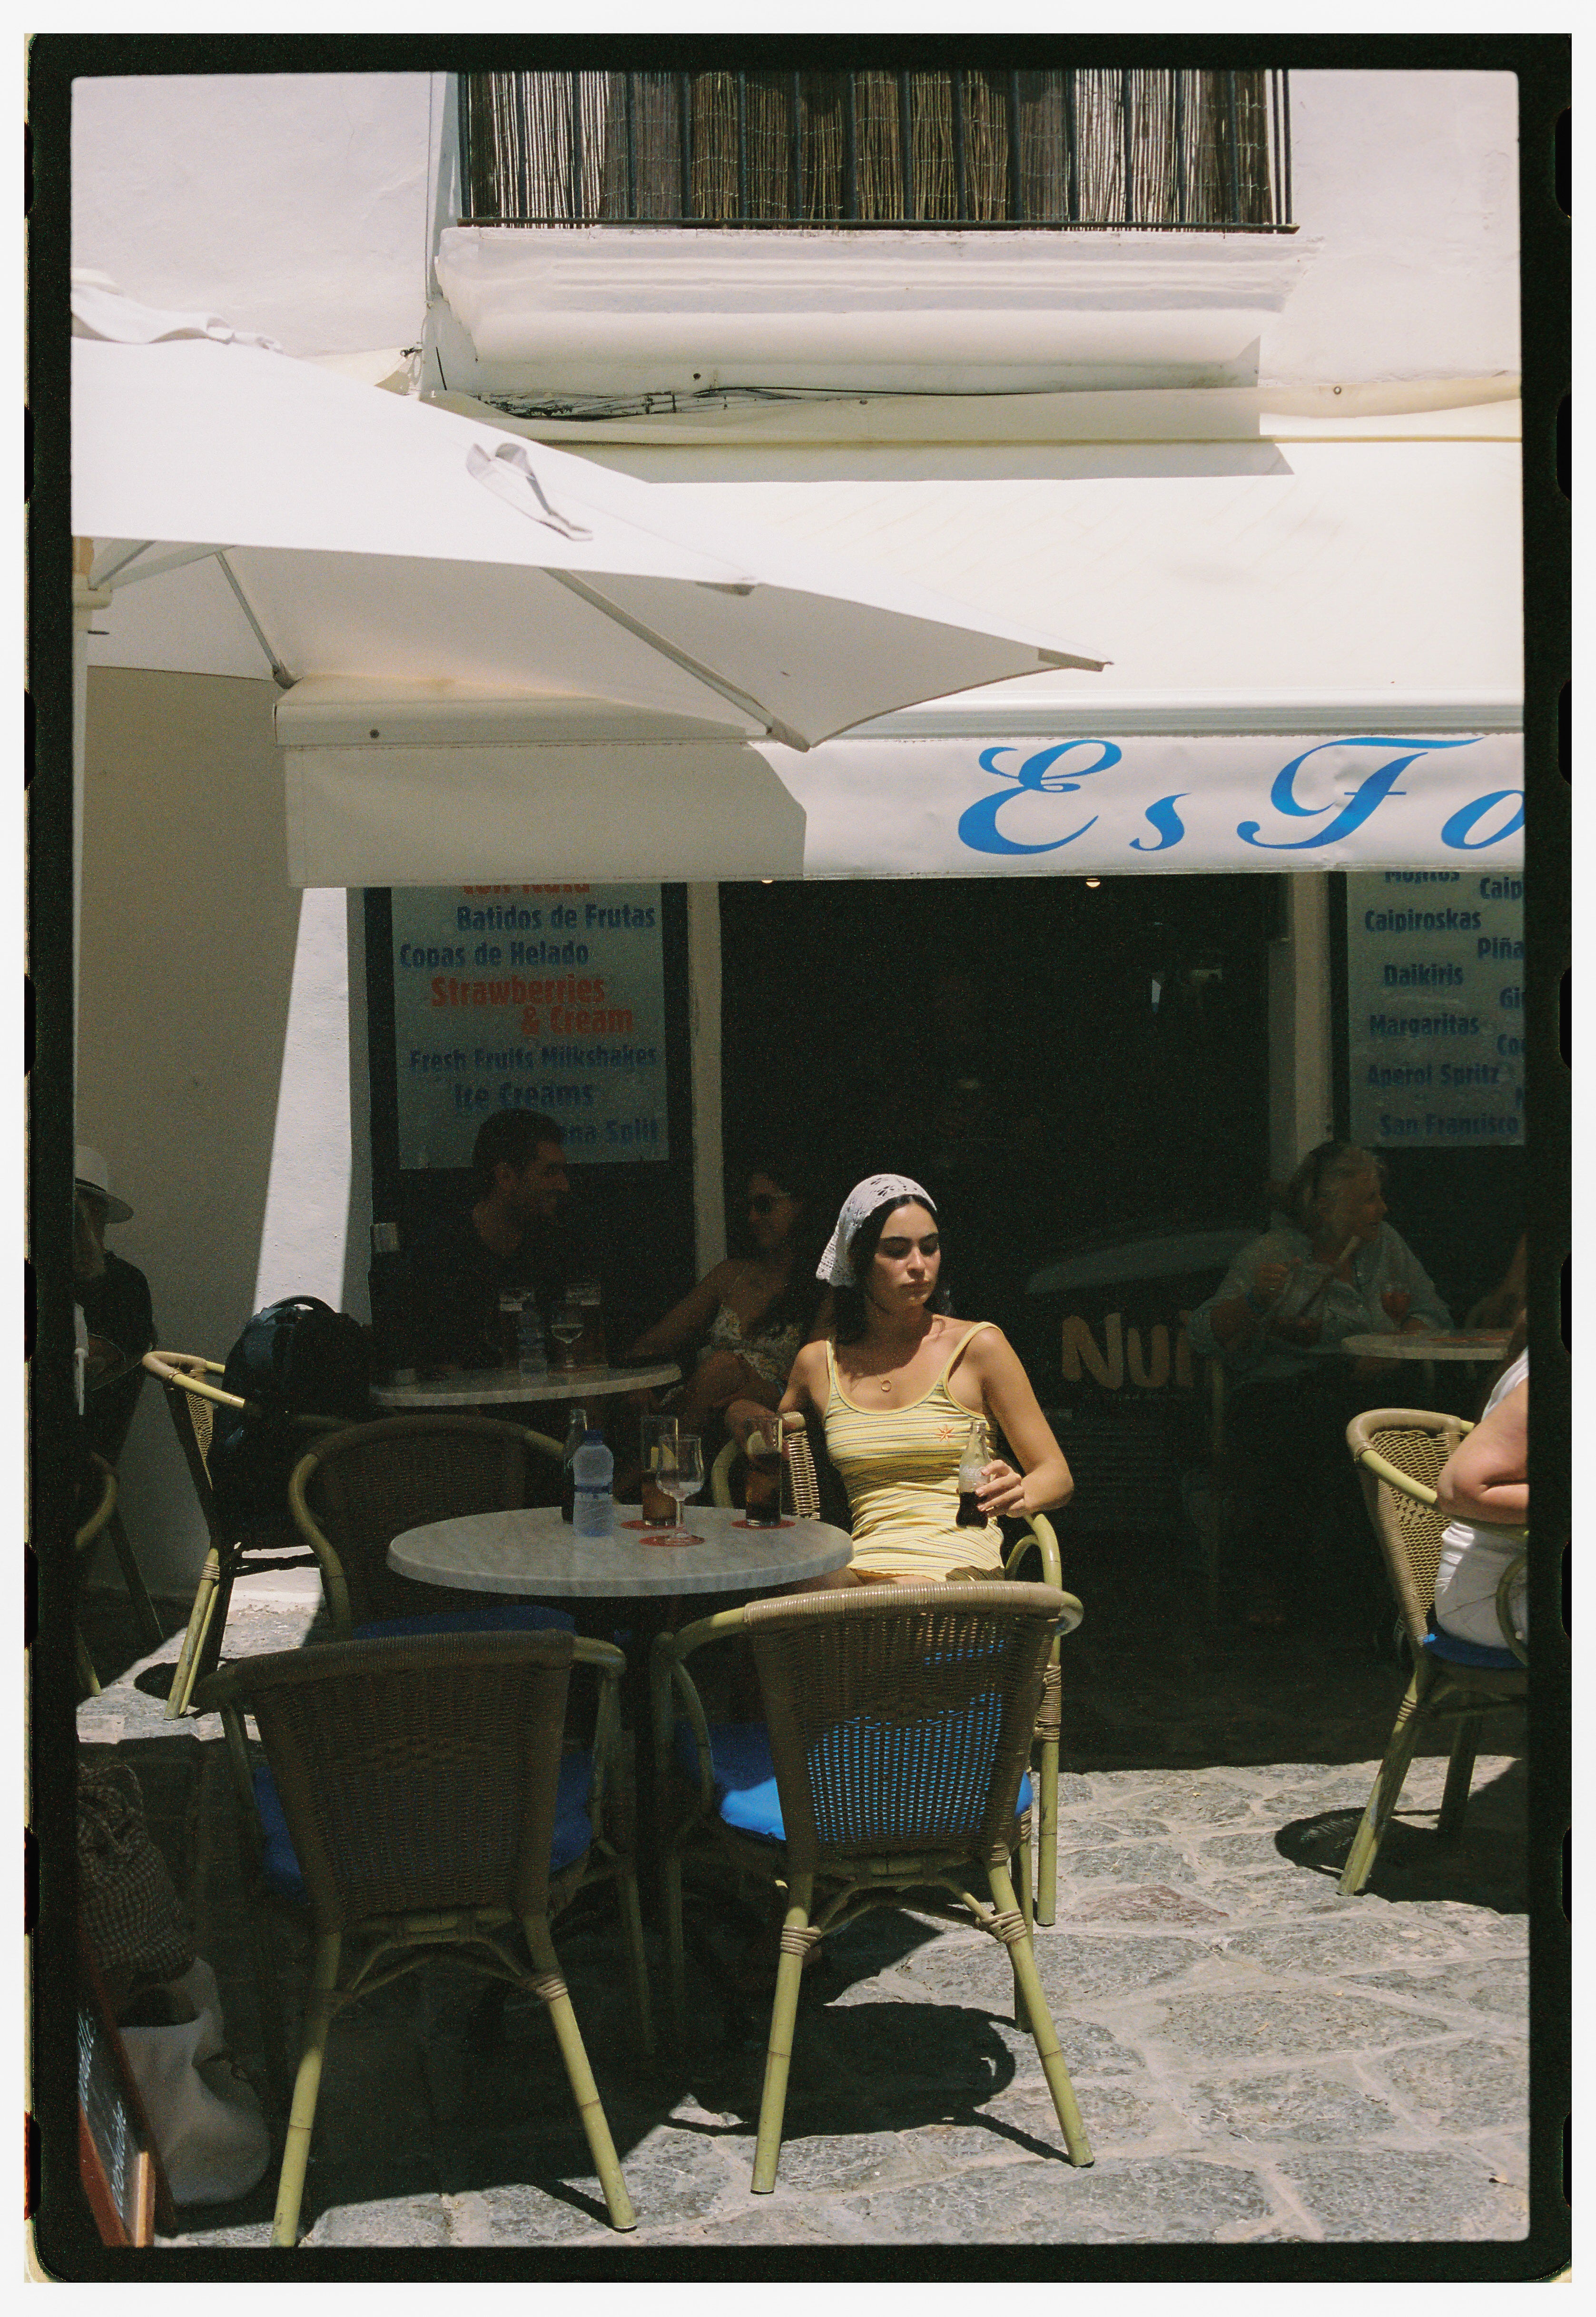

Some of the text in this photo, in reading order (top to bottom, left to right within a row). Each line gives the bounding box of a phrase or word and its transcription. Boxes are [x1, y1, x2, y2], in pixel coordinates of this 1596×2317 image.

[958, 737, 1524, 855] Es Fo
[457, 903, 656, 931] Batidos de Frutas
[1365, 908, 1481, 933] Caipiroskas
[400, 941, 589, 969] Copas de Helado
[1478, 937, 1524, 959] Piña
[1384, 964, 1464, 987] Daikiris
[431, 974, 605, 1007] Strawberries
[521, 1005, 633, 1036] & Cream
[1369, 1012, 1479, 1037] Margaritas
[410, 1045, 657, 1072] Fresh Fruits Milkshakes
[1368, 1063, 1499, 1087] Aperol Spritz
[454, 1081, 594, 1109] Ice Creams
[605, 1118, 658, 1145] Split
[1379, 1113, 1518, 1136] San Francisco
